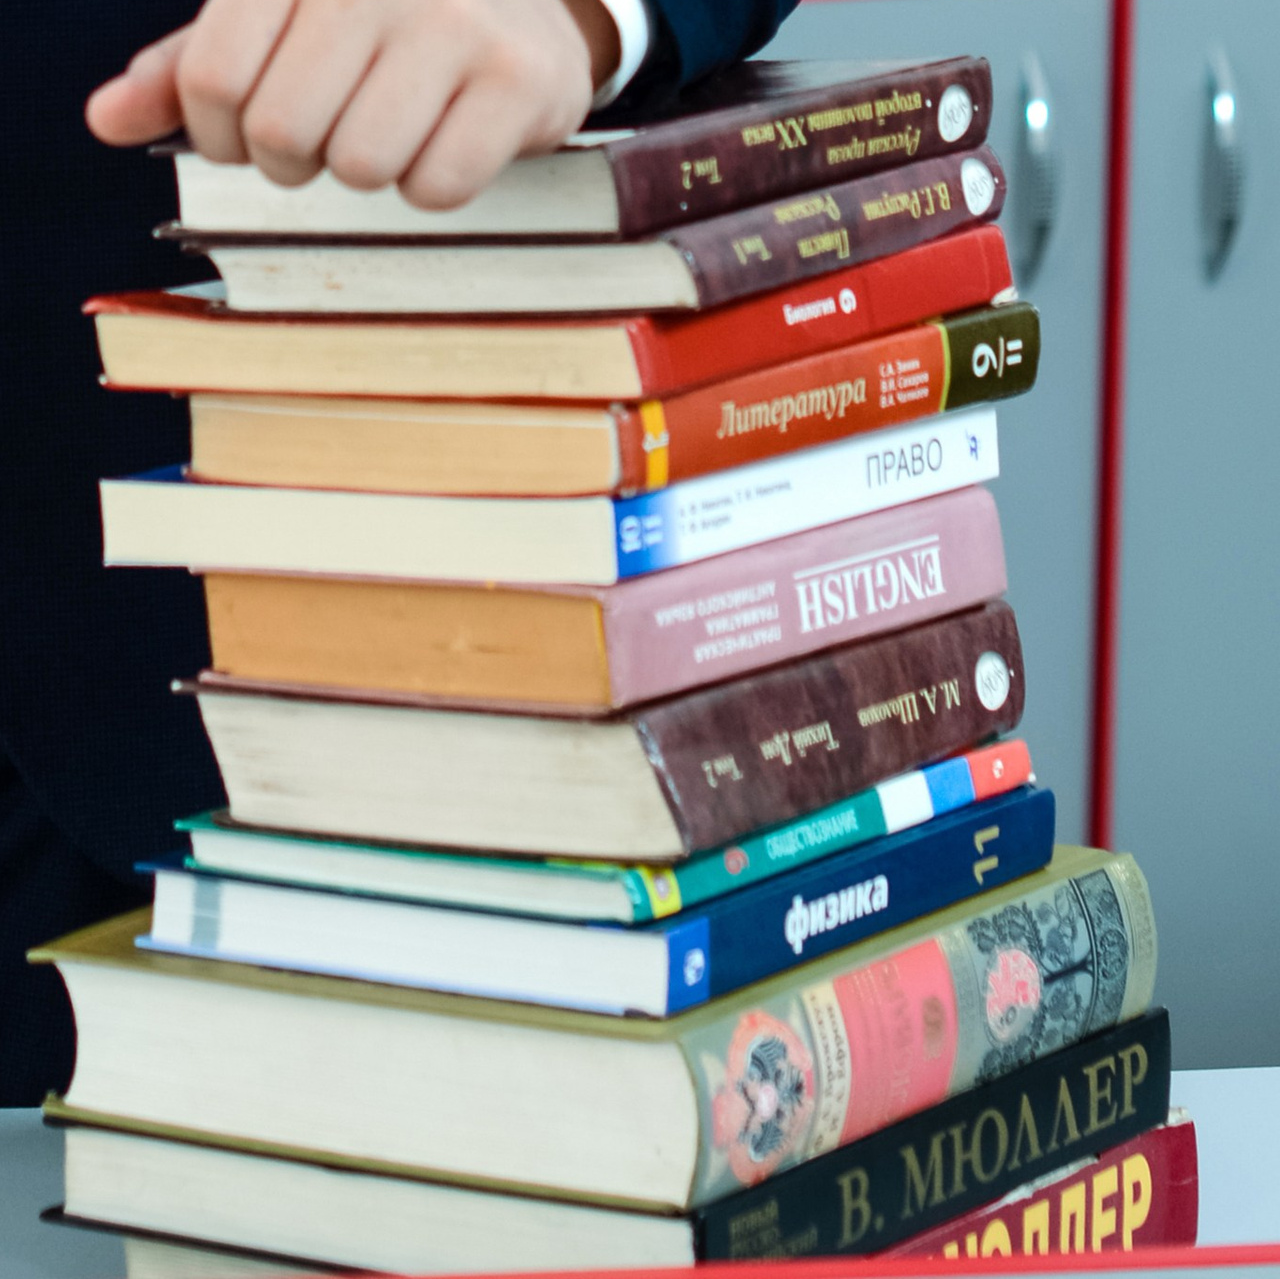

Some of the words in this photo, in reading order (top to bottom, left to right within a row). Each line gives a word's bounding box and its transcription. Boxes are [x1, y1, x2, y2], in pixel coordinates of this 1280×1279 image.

[807, 101, 874, 132] половины
[874, 89, 922, 126] второй
[742, 123, 776, 147] века
[826, 136, 866, 165] проза
[867, 124, 922, 157] Русская
[862, 191, 922, 221] Распутин
[782, 297, 836, 325] Биология
[716, 377, 867, 439] Литература
[866, 438, 943, 489] ПРАВО
[697, 580, 776, 617] АНГЛИЙСКОГО
[795, 546, 946, 634] ENGLISH
[705, 602, 779, 637] ГРАММАТИКА
[694, 624, 782, 663] ПРАКТИЧЕСКАЯ
[857, 692, 919, 727] Шолохов
[759, 730, 793, 765] Дон
[792, 720, 840, 757] Тихий
[784, 874, 889, 954] физика
[836, 1166, 885, 1249] В.
[901, 1043, 1149, 1218] МЮЛЛЕР
